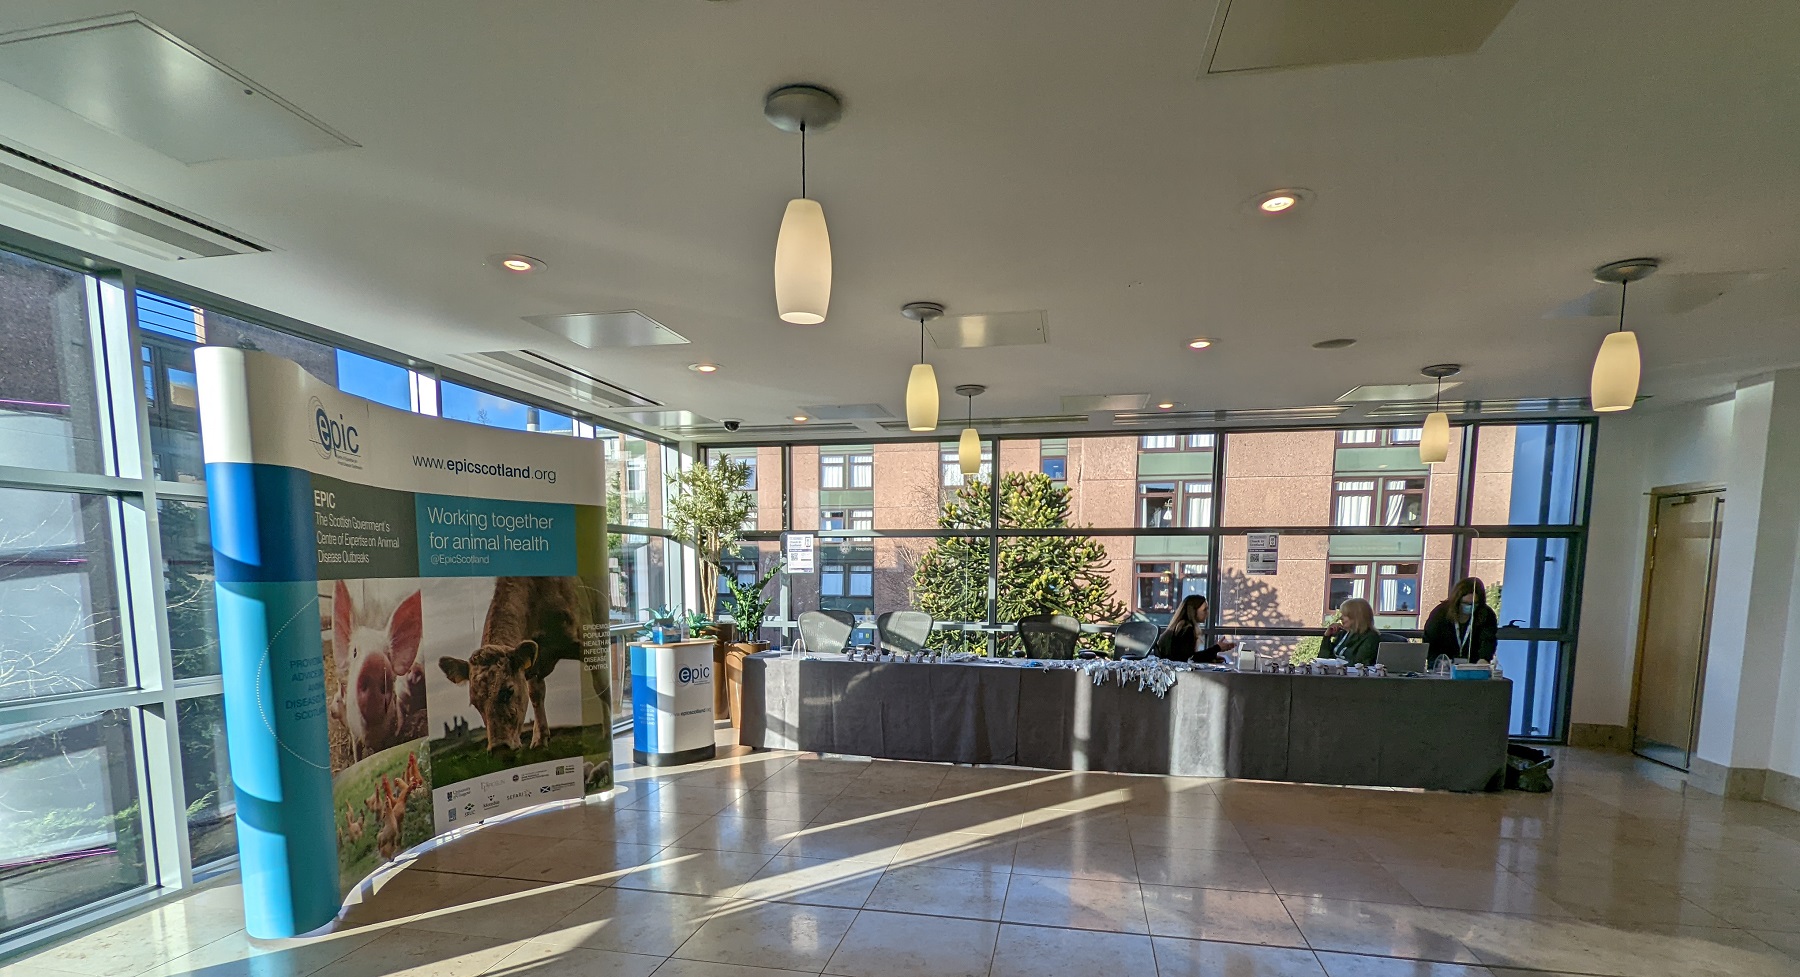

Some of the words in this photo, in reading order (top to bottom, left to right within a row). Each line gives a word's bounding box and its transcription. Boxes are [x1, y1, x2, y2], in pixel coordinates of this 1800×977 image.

[316, 408, 359, 456] epic
[412, 455, 556, 484] www.epicscotland.org
[314, 490, 336, 508] EPIC
[315, 512, 328, 526] The
[328, 514, 352, 528] Scottish
[428, 506, 486, 530] Working
[492, 512, 554, 532] together
[316, 530, 336, 546] Centre
[338, 532, 344, 546] of
[344, 533, 367, 548] Expertise
[377, 536, 400, 548] Animal
[430, 532, 449, 549] for
[452, 534, 500, 550] animal
[504, 535, 549, 551] health
[318, 550, 342, 563] Disease
[342, 550, 370, 563] Outbreaks
[430, 554, 490, 565] @EpicScotland
[678, 664, 710, 683] epic
[506, 792, 524, 800] SEFARI
